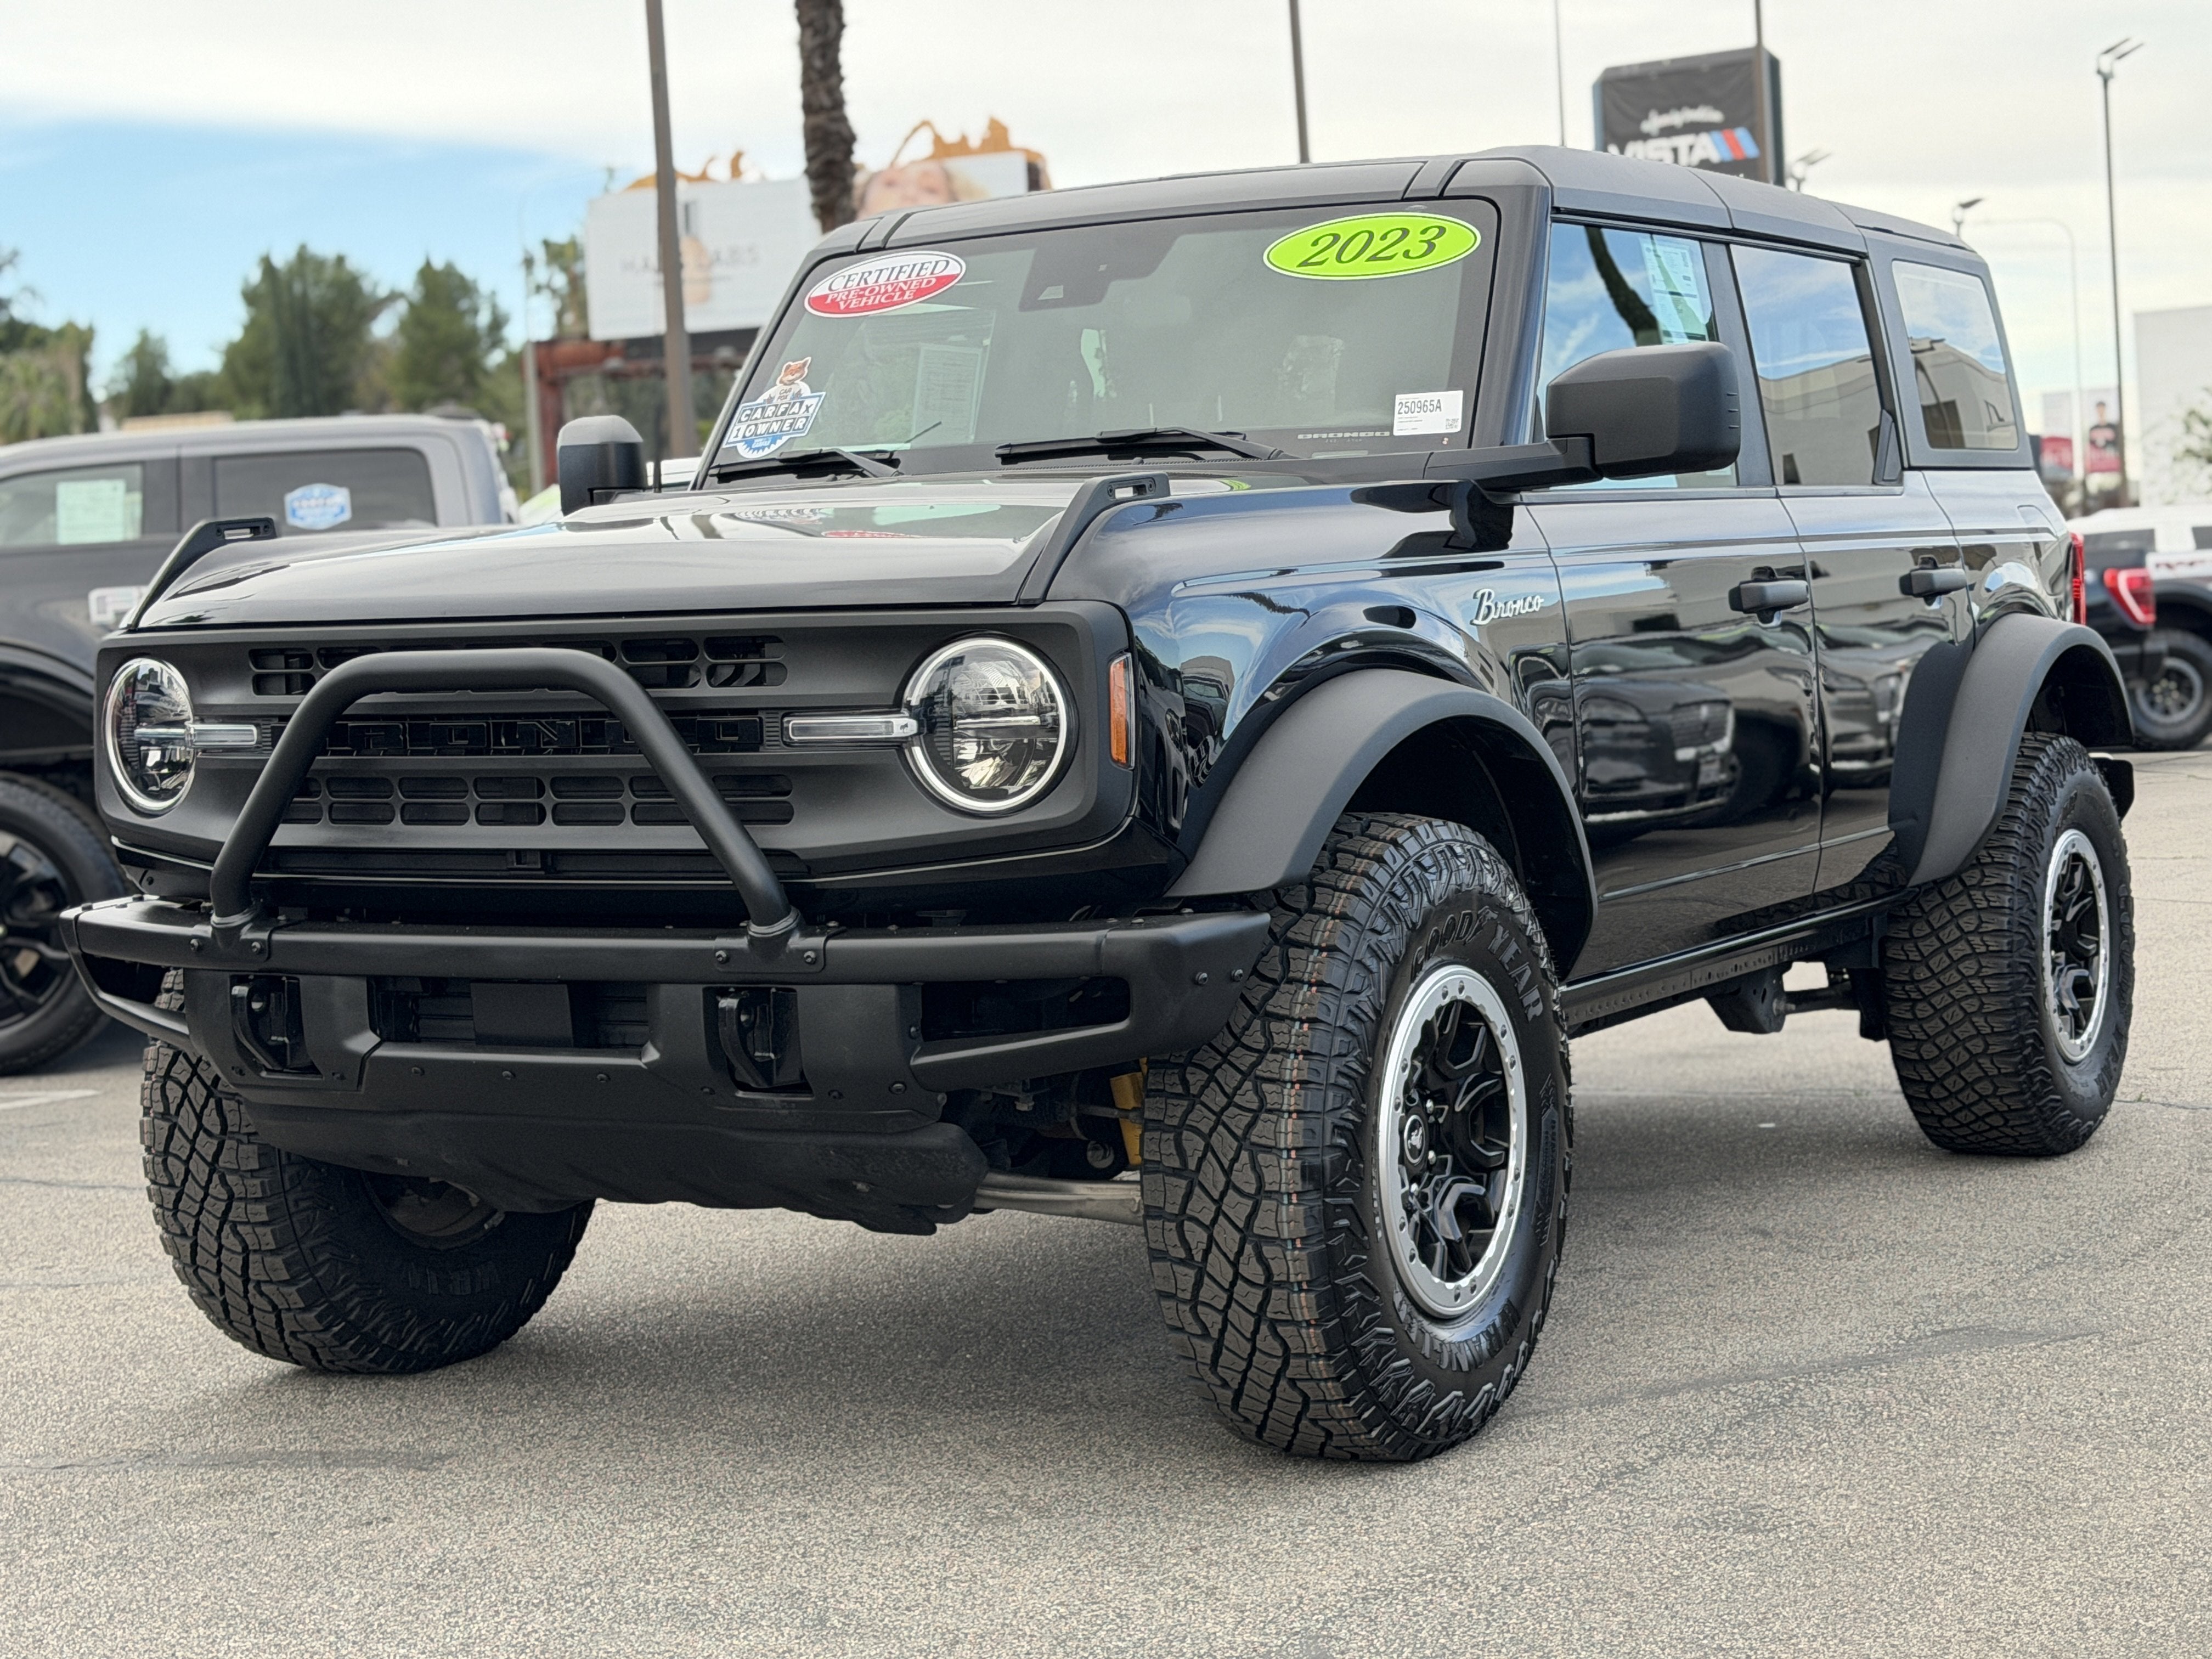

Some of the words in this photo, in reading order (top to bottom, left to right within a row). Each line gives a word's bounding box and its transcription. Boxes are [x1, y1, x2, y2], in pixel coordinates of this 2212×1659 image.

[1296, 225, 1447, 267] 2023
[828, 259, 950, 292] CERTIFIED
[825, 278, 936, 304] PRE-OWNED
[838, 289, 915, 311] VEHICLE
[741, 402, 814, 422] CARFAX
[1397, 399, 1442, 415] 250965A
[1470, 588, 1544, 625] Bronco
